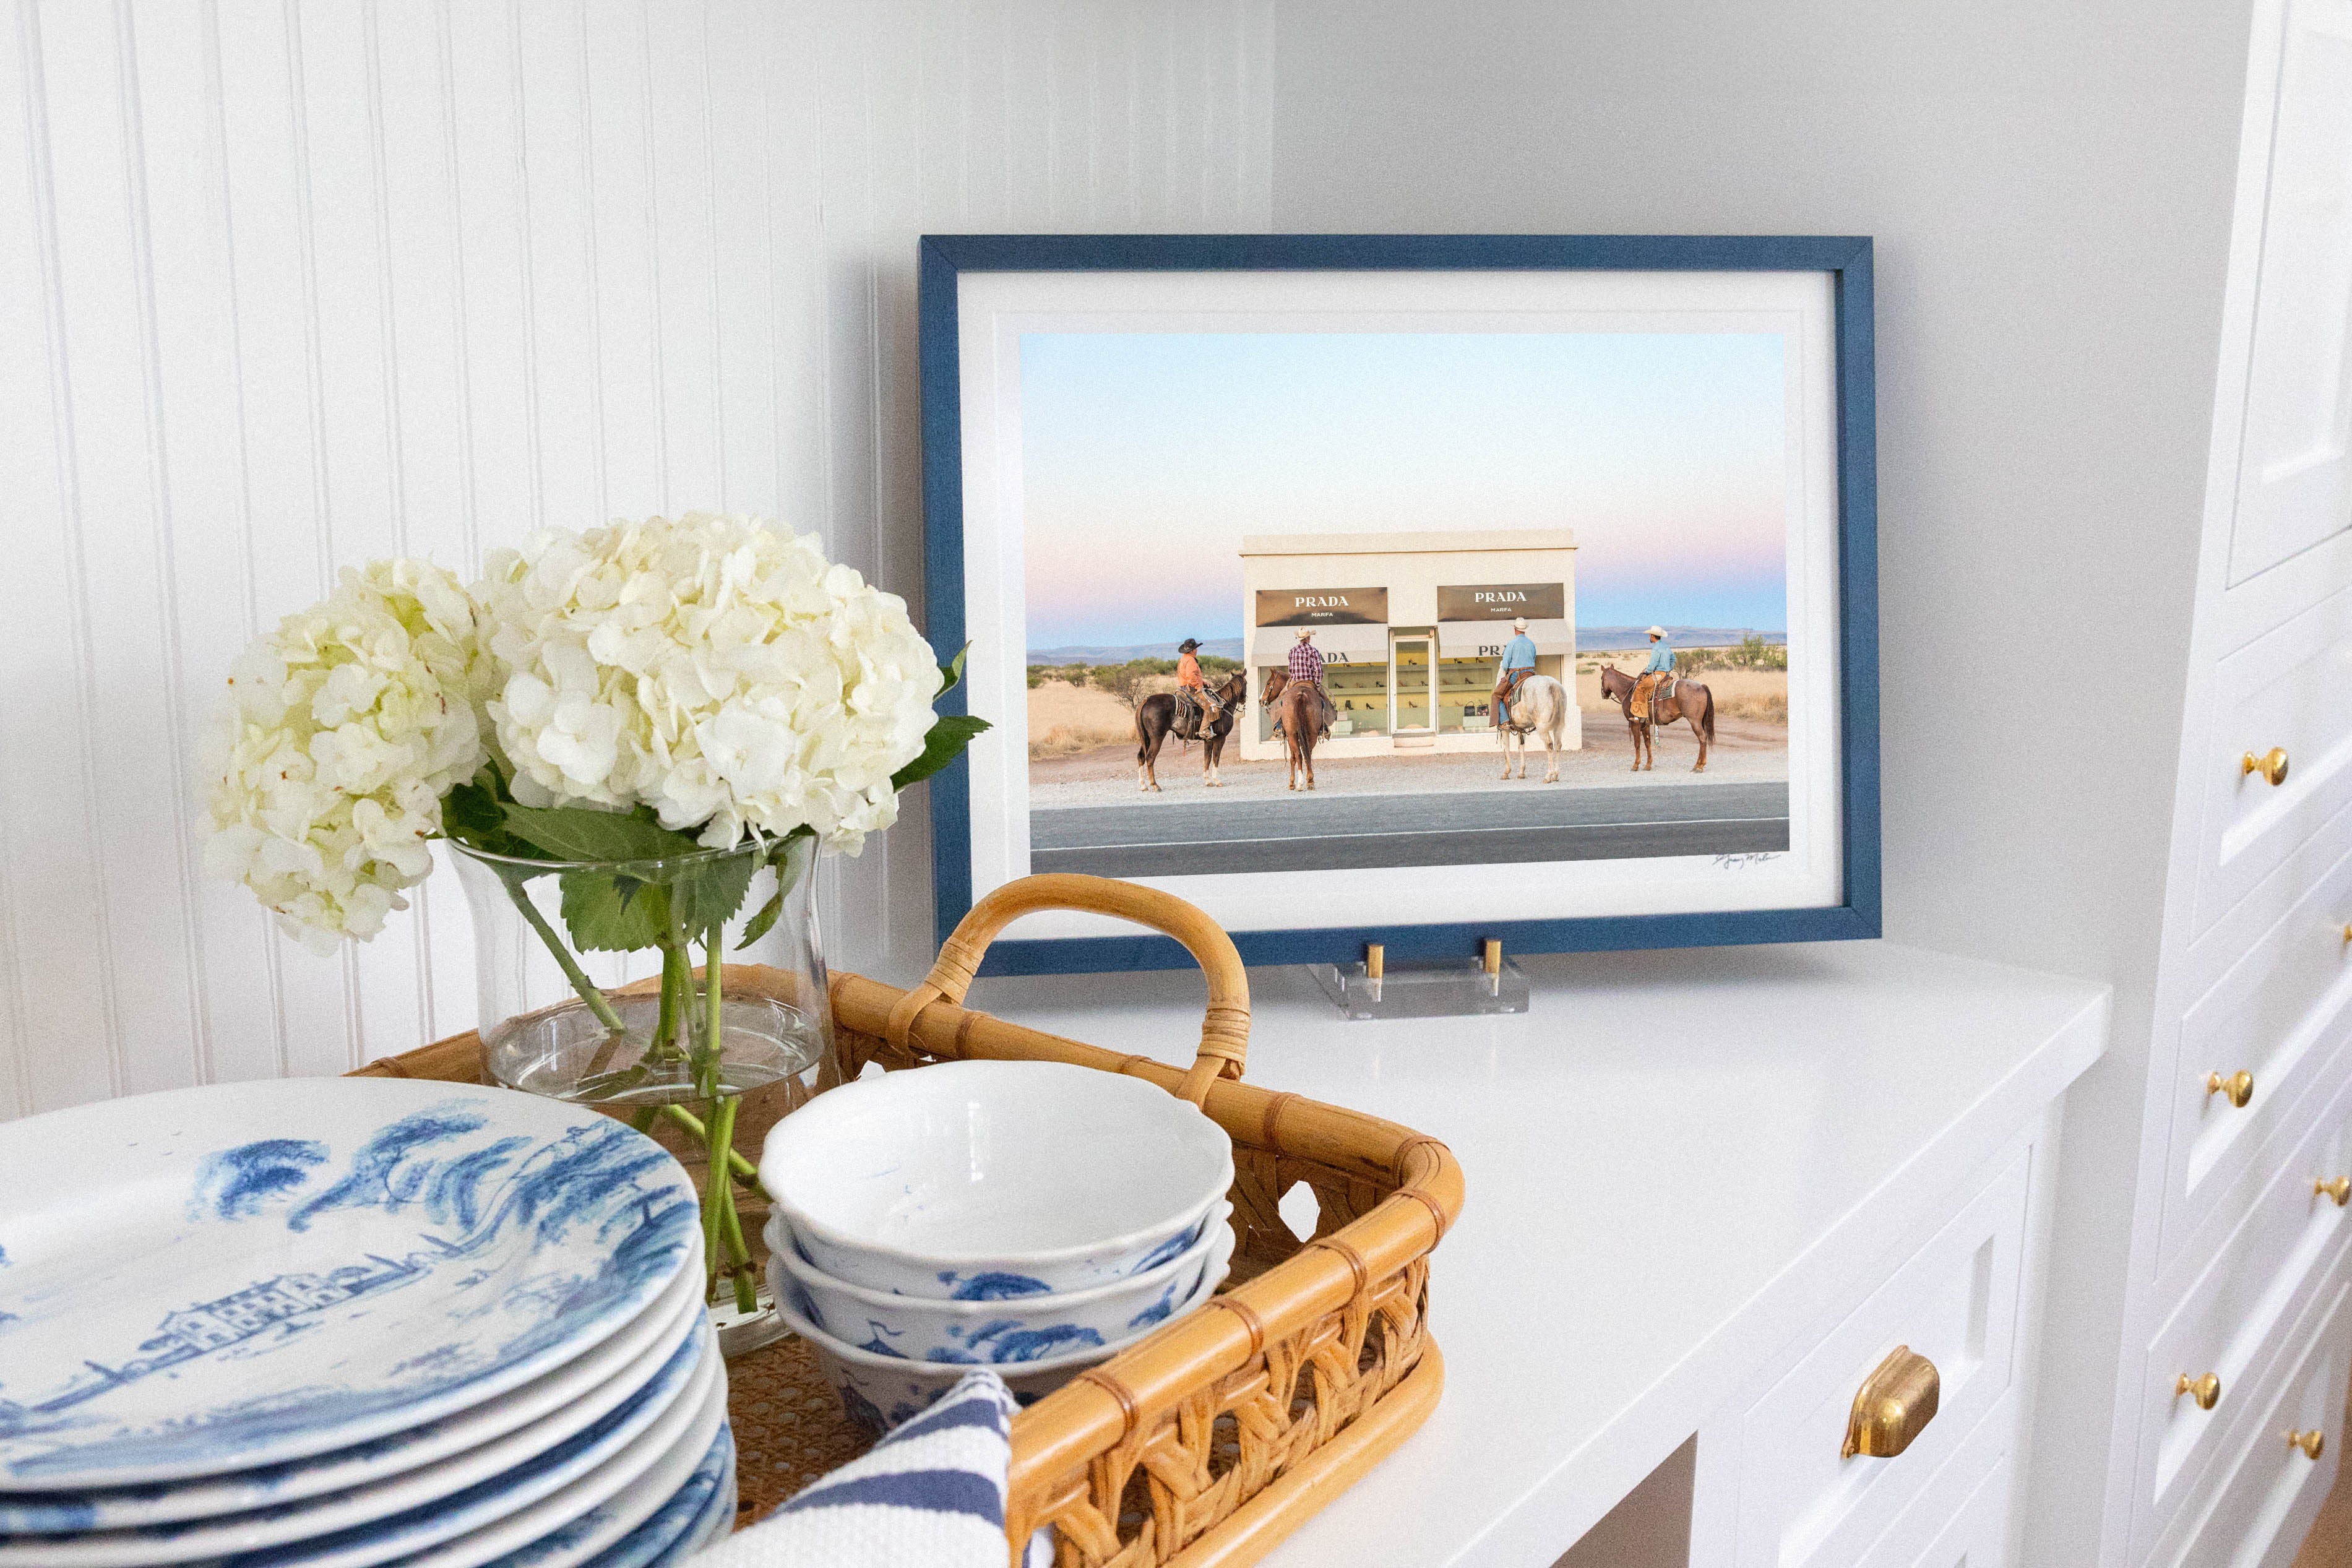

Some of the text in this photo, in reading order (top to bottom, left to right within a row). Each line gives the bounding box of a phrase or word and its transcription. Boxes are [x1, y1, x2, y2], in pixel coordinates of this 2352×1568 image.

[1294, 596, 1349, 607] PRADA
[1475, 592, 1527, 603] PRADA
[1319, 652, 1349, 663] ADA
